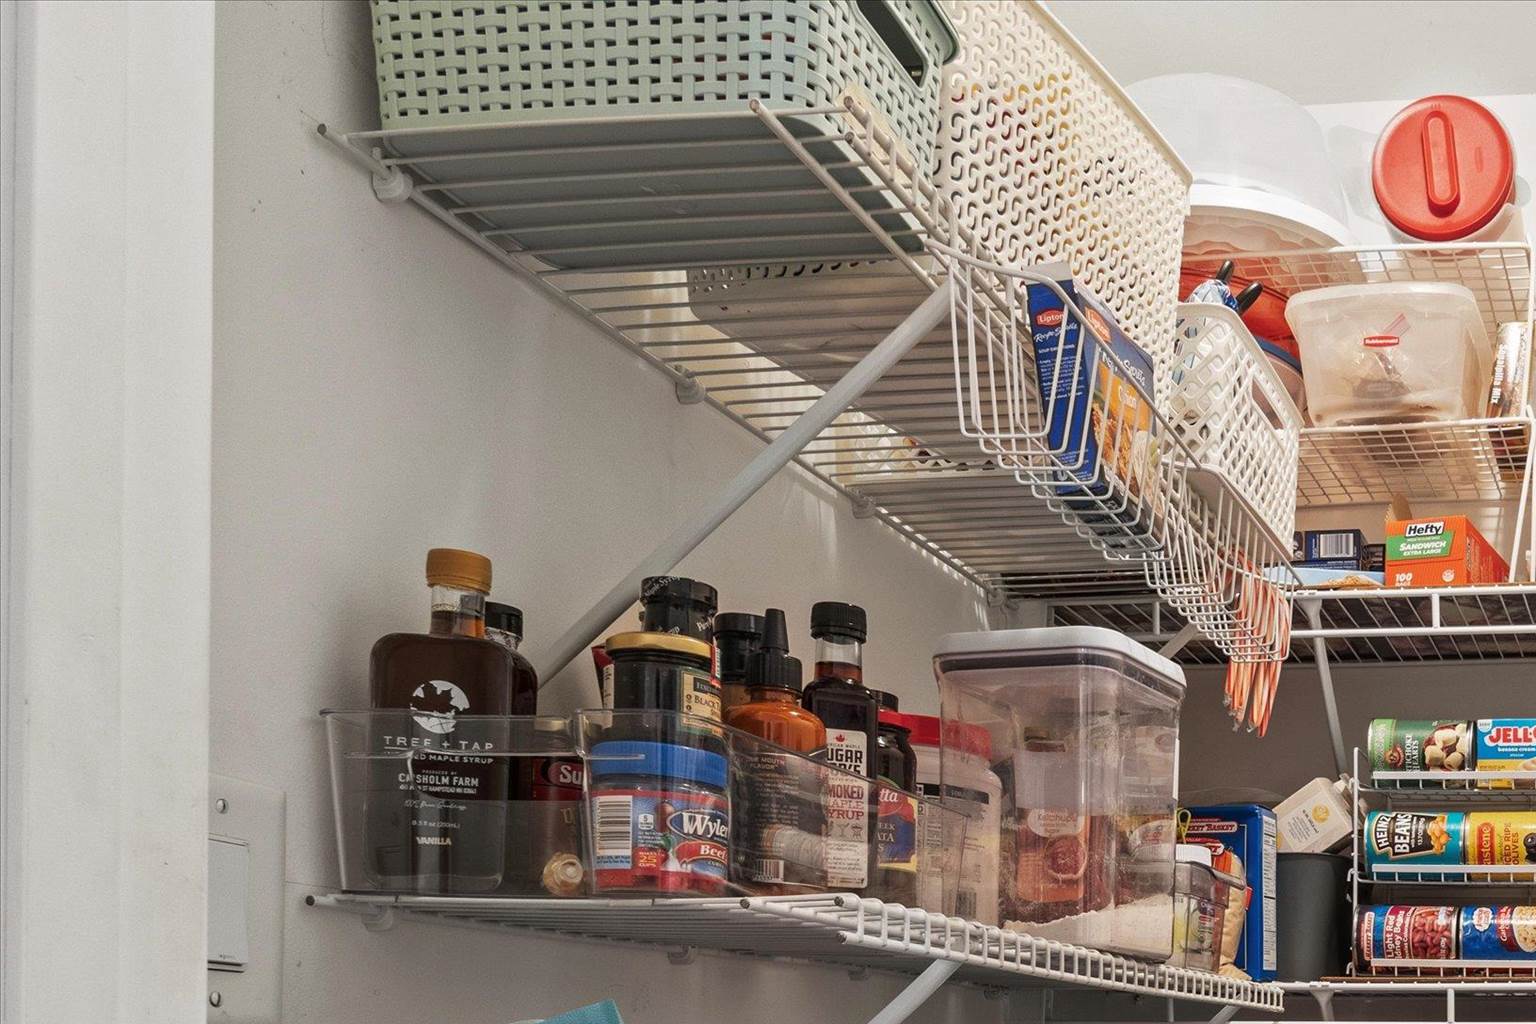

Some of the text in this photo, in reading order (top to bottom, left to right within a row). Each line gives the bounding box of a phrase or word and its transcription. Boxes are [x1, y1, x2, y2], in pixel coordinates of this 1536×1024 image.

[1408, 522, 1443, 537] Hefty
[1399, 540, 1447, 551] SANDWICH
[1395, 573, 1413, 582] 100
[459, 740, 494, 751] TAP
[429, 754, 460, 763] MAPLE
[463, 756, 494, 765] SYRUP
[453, 776, 479, 787] FARM
[1377, 815, 1391, 847] HEINZ
[1394, 812, 1412, 853] BEANS
[416, 836, 452, 846] VANILLA
[1512, 832, 1520, 865] OLIVES
[1394, 911, 1404, 933] Beans
[1385, 915, 1395, 958] Light Red
